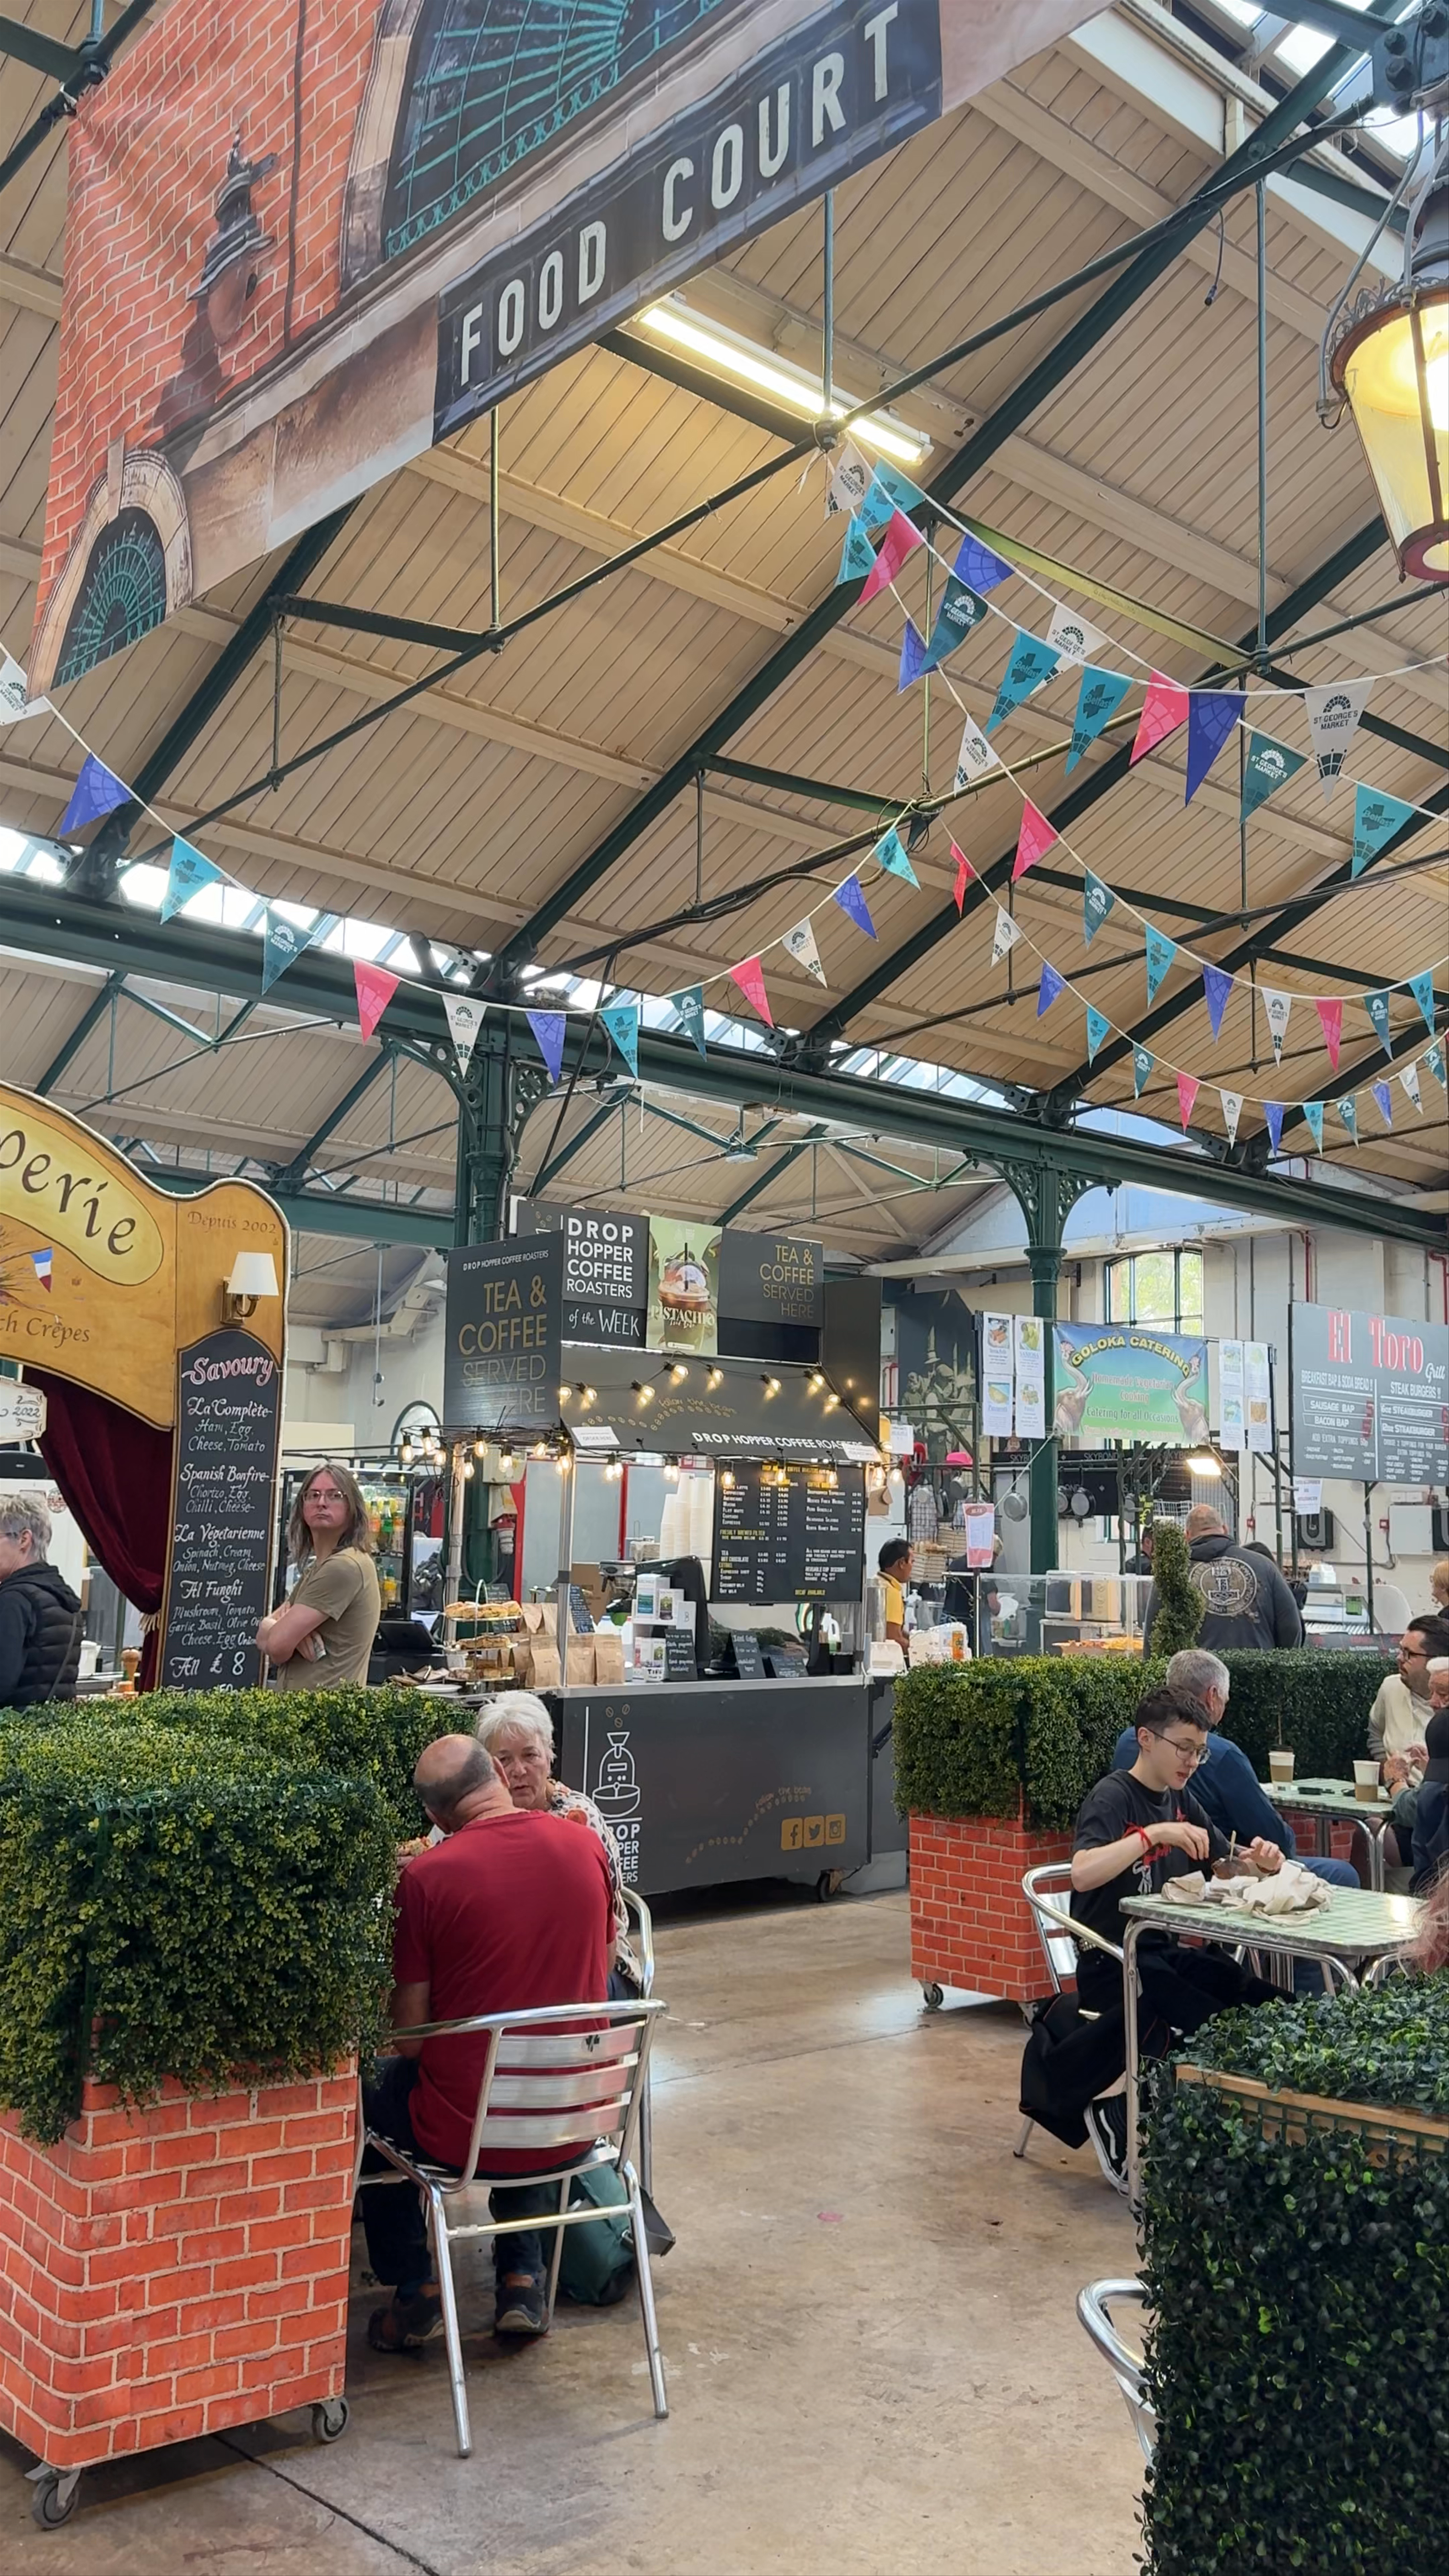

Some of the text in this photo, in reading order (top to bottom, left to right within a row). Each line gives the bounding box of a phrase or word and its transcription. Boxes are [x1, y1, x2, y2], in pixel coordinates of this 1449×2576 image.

[461, 4, 898, 387] FOOD COURT
[840, 475, 859, 497] MARKET
[944, 603, 976, 625] ST GEORGE'S
[946, 612, 966, 627] MARKET
[1054, 638, 1076, 656] MARKET
[1058, 633, 1086, 655] GEORGE'S
[1015, 660, 1041, 679] Belfast
[1086, 694, 1114, 709] Belfast
[1321, 720, 1349, 730] MARKET
[1324, 710, 1358, 723] GEORGE'S
[966, 746, 981, 767] MARKET
[1254, 763, 1278, 780] MARKET
[1258, 759, 1287, 779] GEORGE'S
[1364, 809, 1394, 827] Belfast
[270, 938, 291, 954] MARKET
[188, 1210, 276, 1234] Depuis 2002
[568, 1217, 634, 1244] DROP
[463, 1250, 549, 1271] DROP HOPPER COFFEE ROASTERS
[568, 1240, 633, 1263] HOPPER
[775, 1245, 814, 1266] TEA &
[567, 1259, 633, 1282] COFFEE
[759, 1263, 814, 1286] COFFEE
[483, 1275, 547, 1314] TEA &
[567, 1279, 633, 1299] ROASTERS
[763, 1283, 814, 1301] SERVED
[781, 1303, 814, 1319] HERE
[26, 1317, 91, 1349] Crêpes
[569, 1309, 640, 1337] of the WEEK
[458, 1314, 548, 1355] COFFEE
[1327, 1310, 1446, 1383] El Toro Grill
[1072, 1336, 1126, 1367] GOLOKA
[1129, 1336, 1190, 1379] CATERING
[182, 1356, 274, 1387] Savoury
[463, 1355, 546, 1388] SERVED
[1092, 1372, 1174, 1390] Homemade Vegetarian
[1301, 1369, 1327, 1385] BREAKFAST
[1328, 1373, 1337, 1387] BAP
[1341, 1375, 1354, 1389] SODA
[1354, 1378, 1369, 1391] BREAD
[1120, 1390, 1149, 1403] Cooking
[1390, 1381, 1437, 1399] STEAK BURGERS
[12, 1406, 41, 1418] 2022
[187, 1396, 273, 1423] La Complète
[1086, 1406, 1179, 1423] Catering for all Occasions
[1310, 1400, 1355, 1413] SAUSAGE BAP
[1392, 1406, 1433, 1418] STEAKBURGER
[1314, 1416, 1349, 1428] BACON BAP
[1395, 1424, 1435, 1436] STEAKBURGER
[227, 1438, 265, 1452] Tomato
[692, 1432, 863, 1449] DROP HOPPER COFFEE ROAS
[1322, 1434, 1337, 1443] EXTRA
[1338, 1435, 1358, 1446] TOPPINGS
[1401, 1439, 1417, 1448] TOPPINGS
[1409, 1449, 1425, 1457] TOPPINGS
[180, 1463, 270, 1490] Spanish Bonfire
[218, 1500, 255, 1513] Cheese
[174, 1523, 194, 1543] La
[237, 1559, 266, 1572] Cheese
[180, 1579, 244, 1604] Al Funghi
[169, 1656, 201, 1678] All
[232, 1650, 246, 1676] 8
